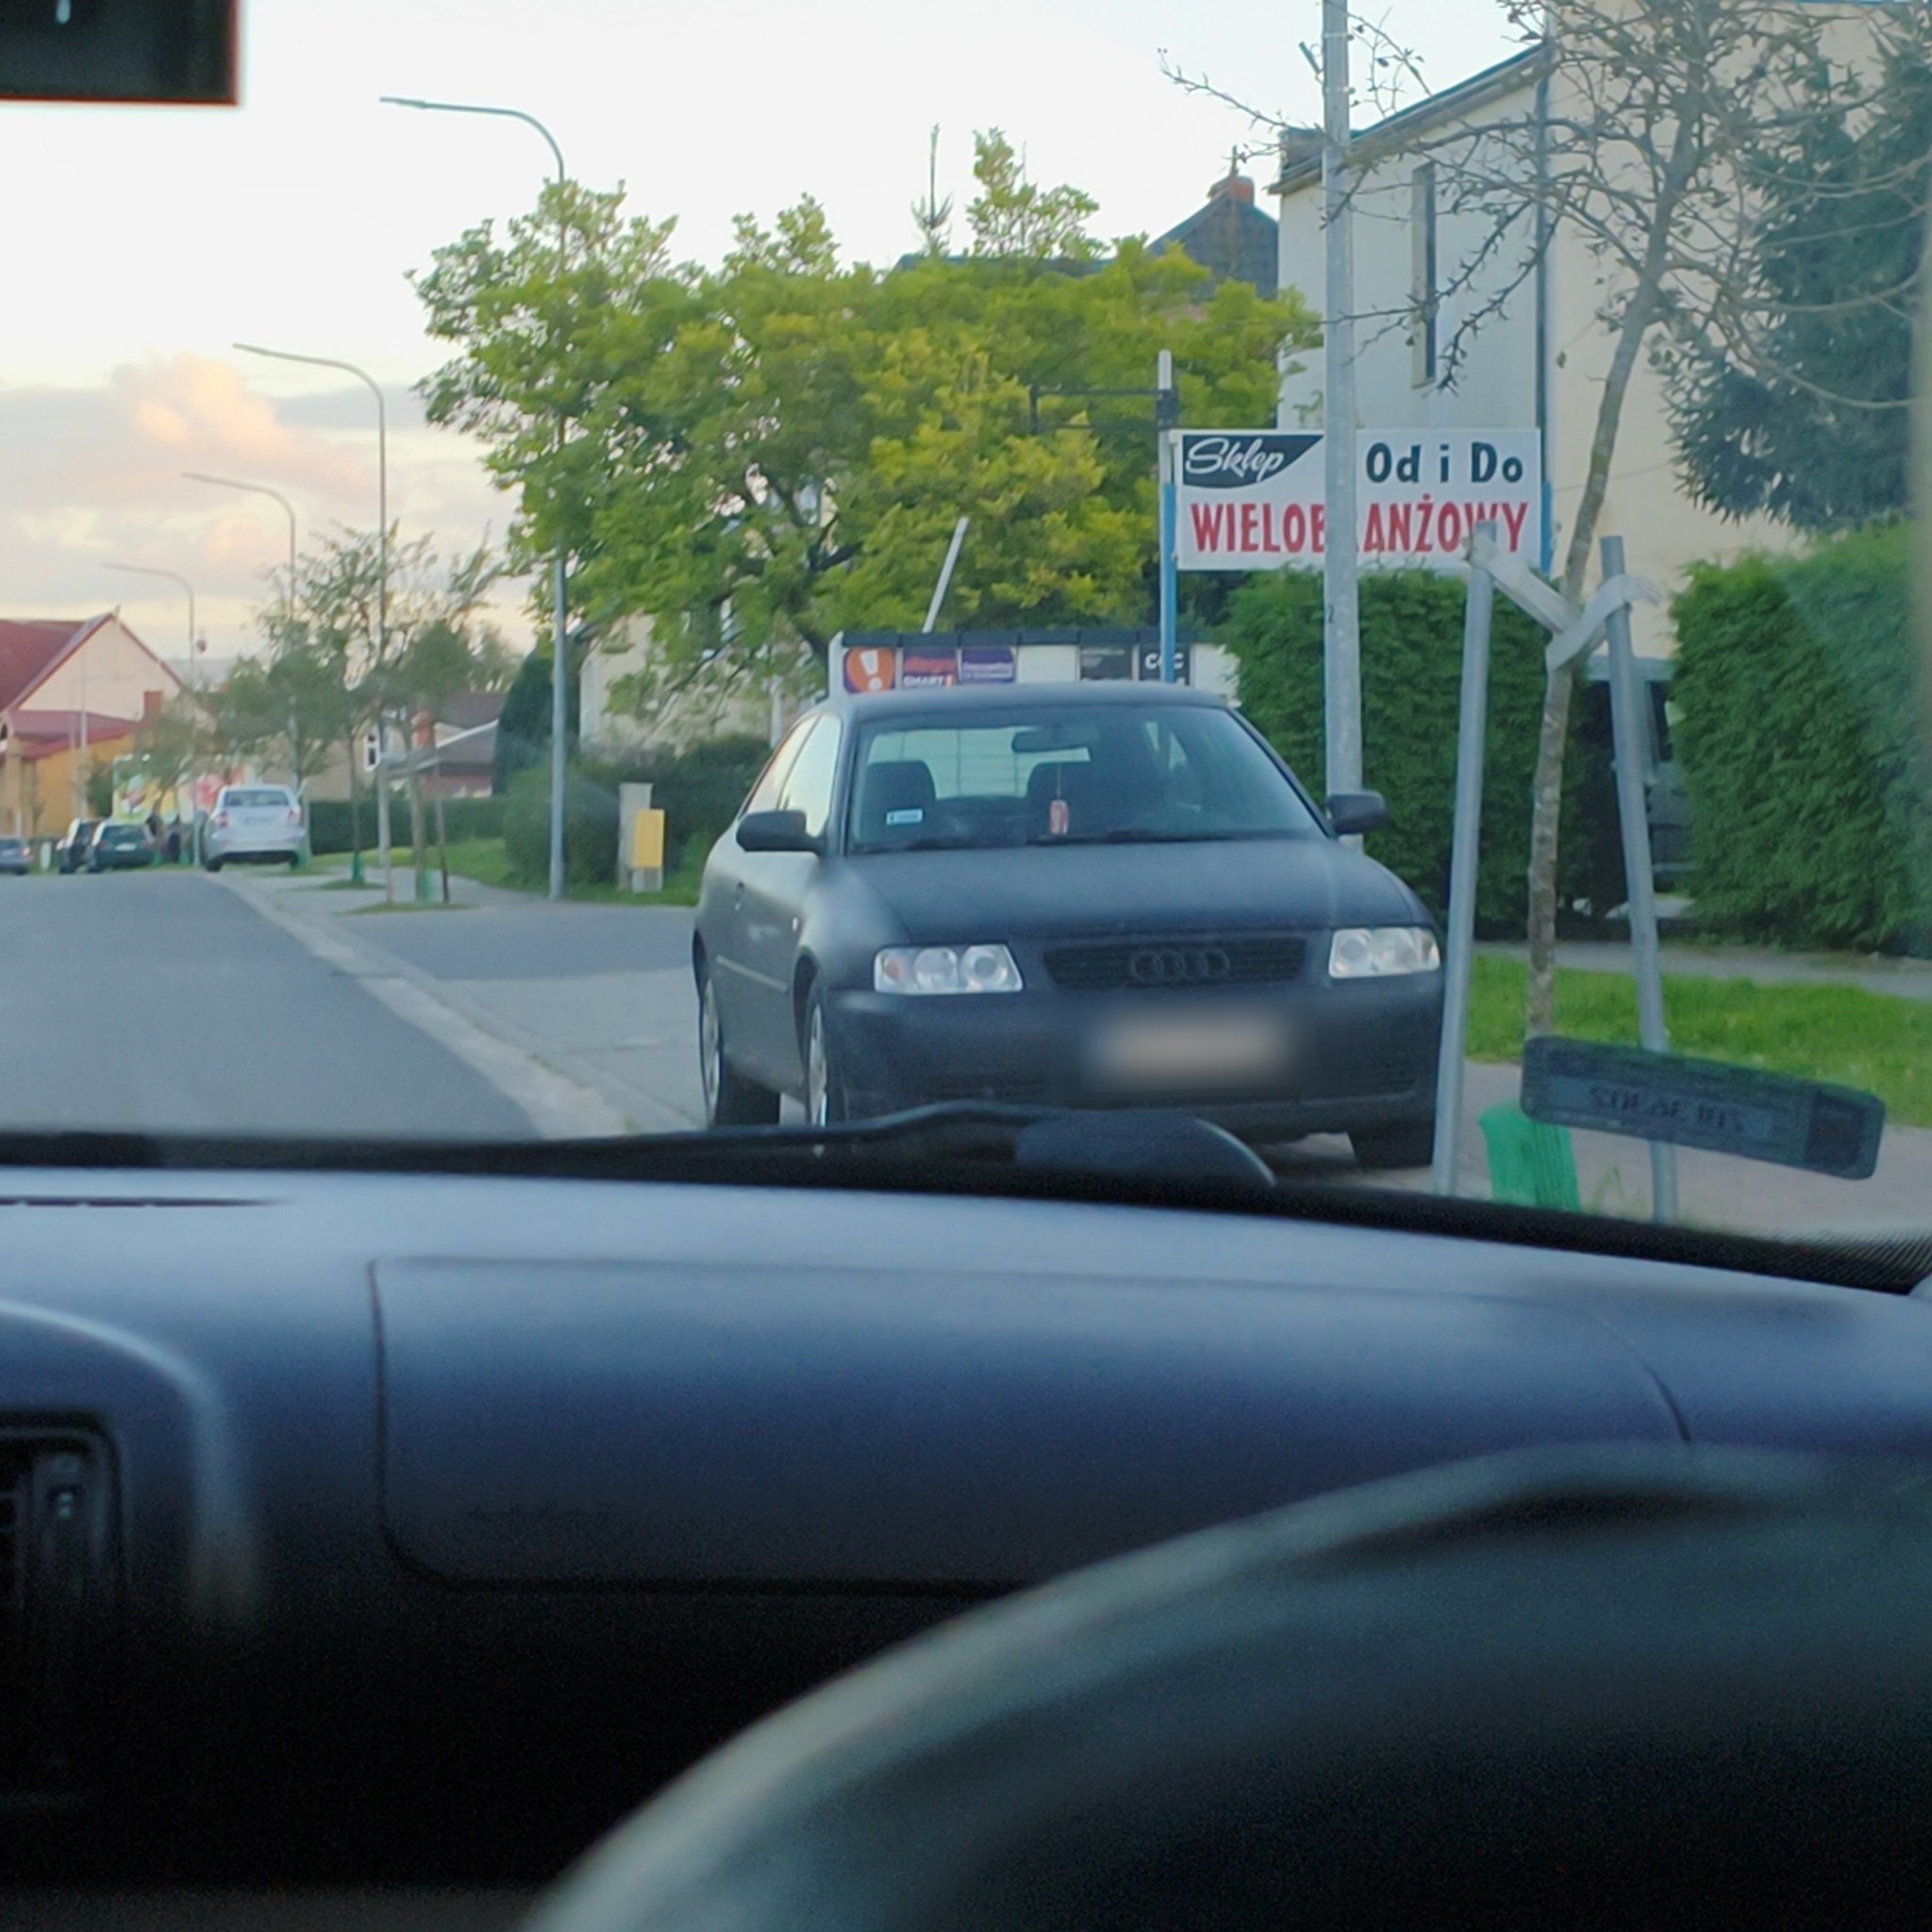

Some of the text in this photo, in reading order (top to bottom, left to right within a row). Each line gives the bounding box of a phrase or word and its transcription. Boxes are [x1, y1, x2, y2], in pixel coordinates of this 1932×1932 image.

[1186, 437, 1284, 483] Sklep
[1365, 441, 1524, 484] Od i Do
[1191, 492, 1528, 554] WIELOBANŻOY
